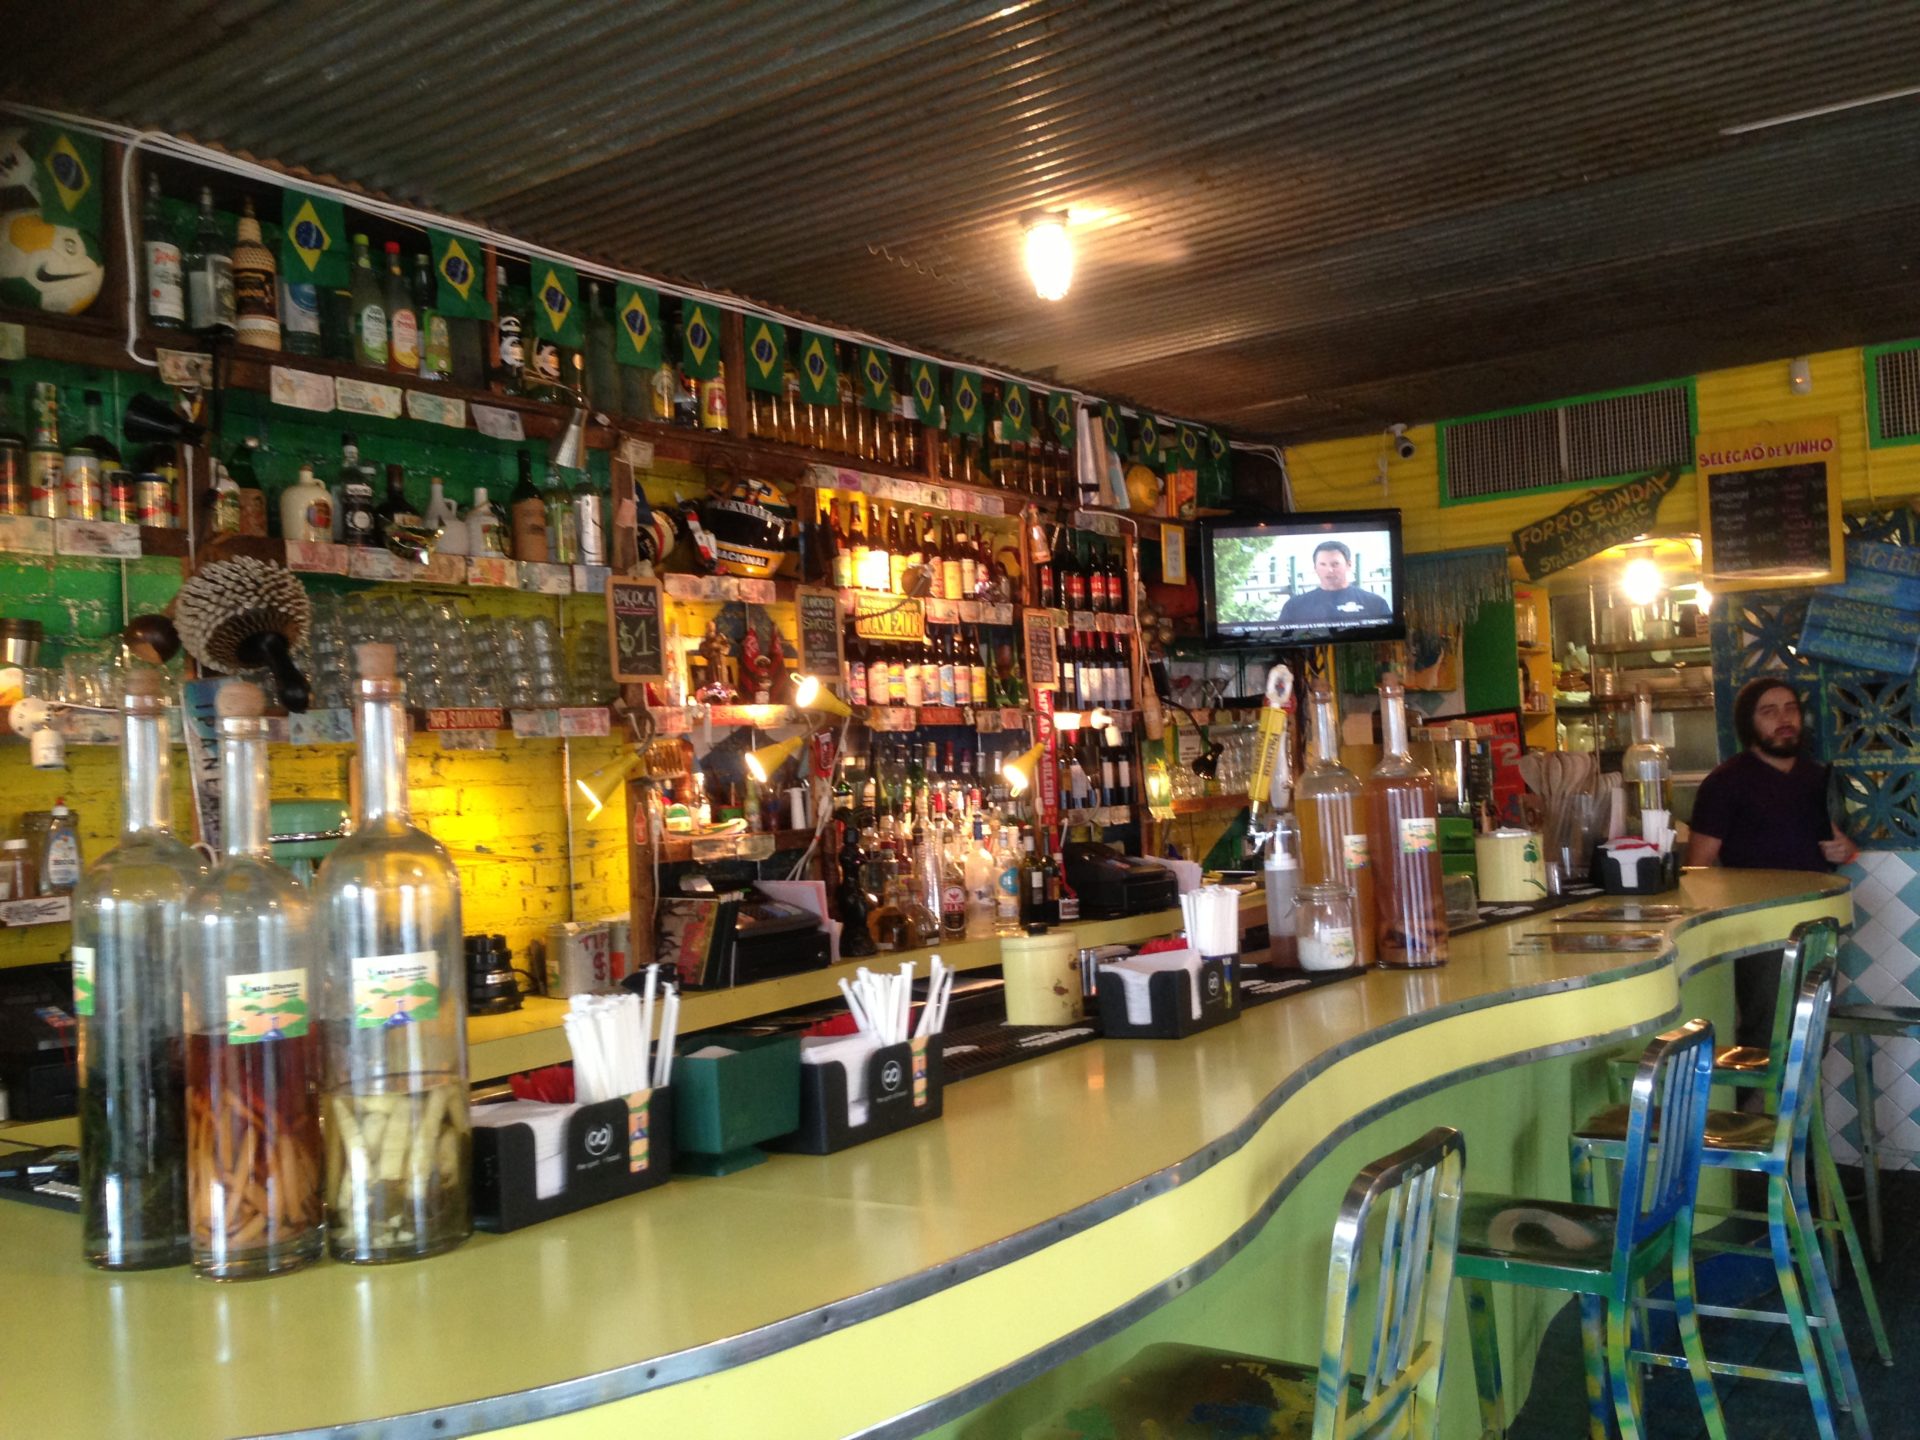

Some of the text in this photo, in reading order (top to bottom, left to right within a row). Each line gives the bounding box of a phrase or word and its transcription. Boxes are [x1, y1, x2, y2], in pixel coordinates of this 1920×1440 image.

[1768, 446, 1782, 458] DE
[1784, 437, 1833, 456] VINHO
[1519, 511, 1584, 551] FORRO
[1588, 471, 1671, 522] SUNDAY
[1597, 503, 1650, 535] MUSIC
[619, 620, 655, 657] $1
[803, 618, 837, 633] SHOTS
[431, 709, 501, 728] NO SMOKING
